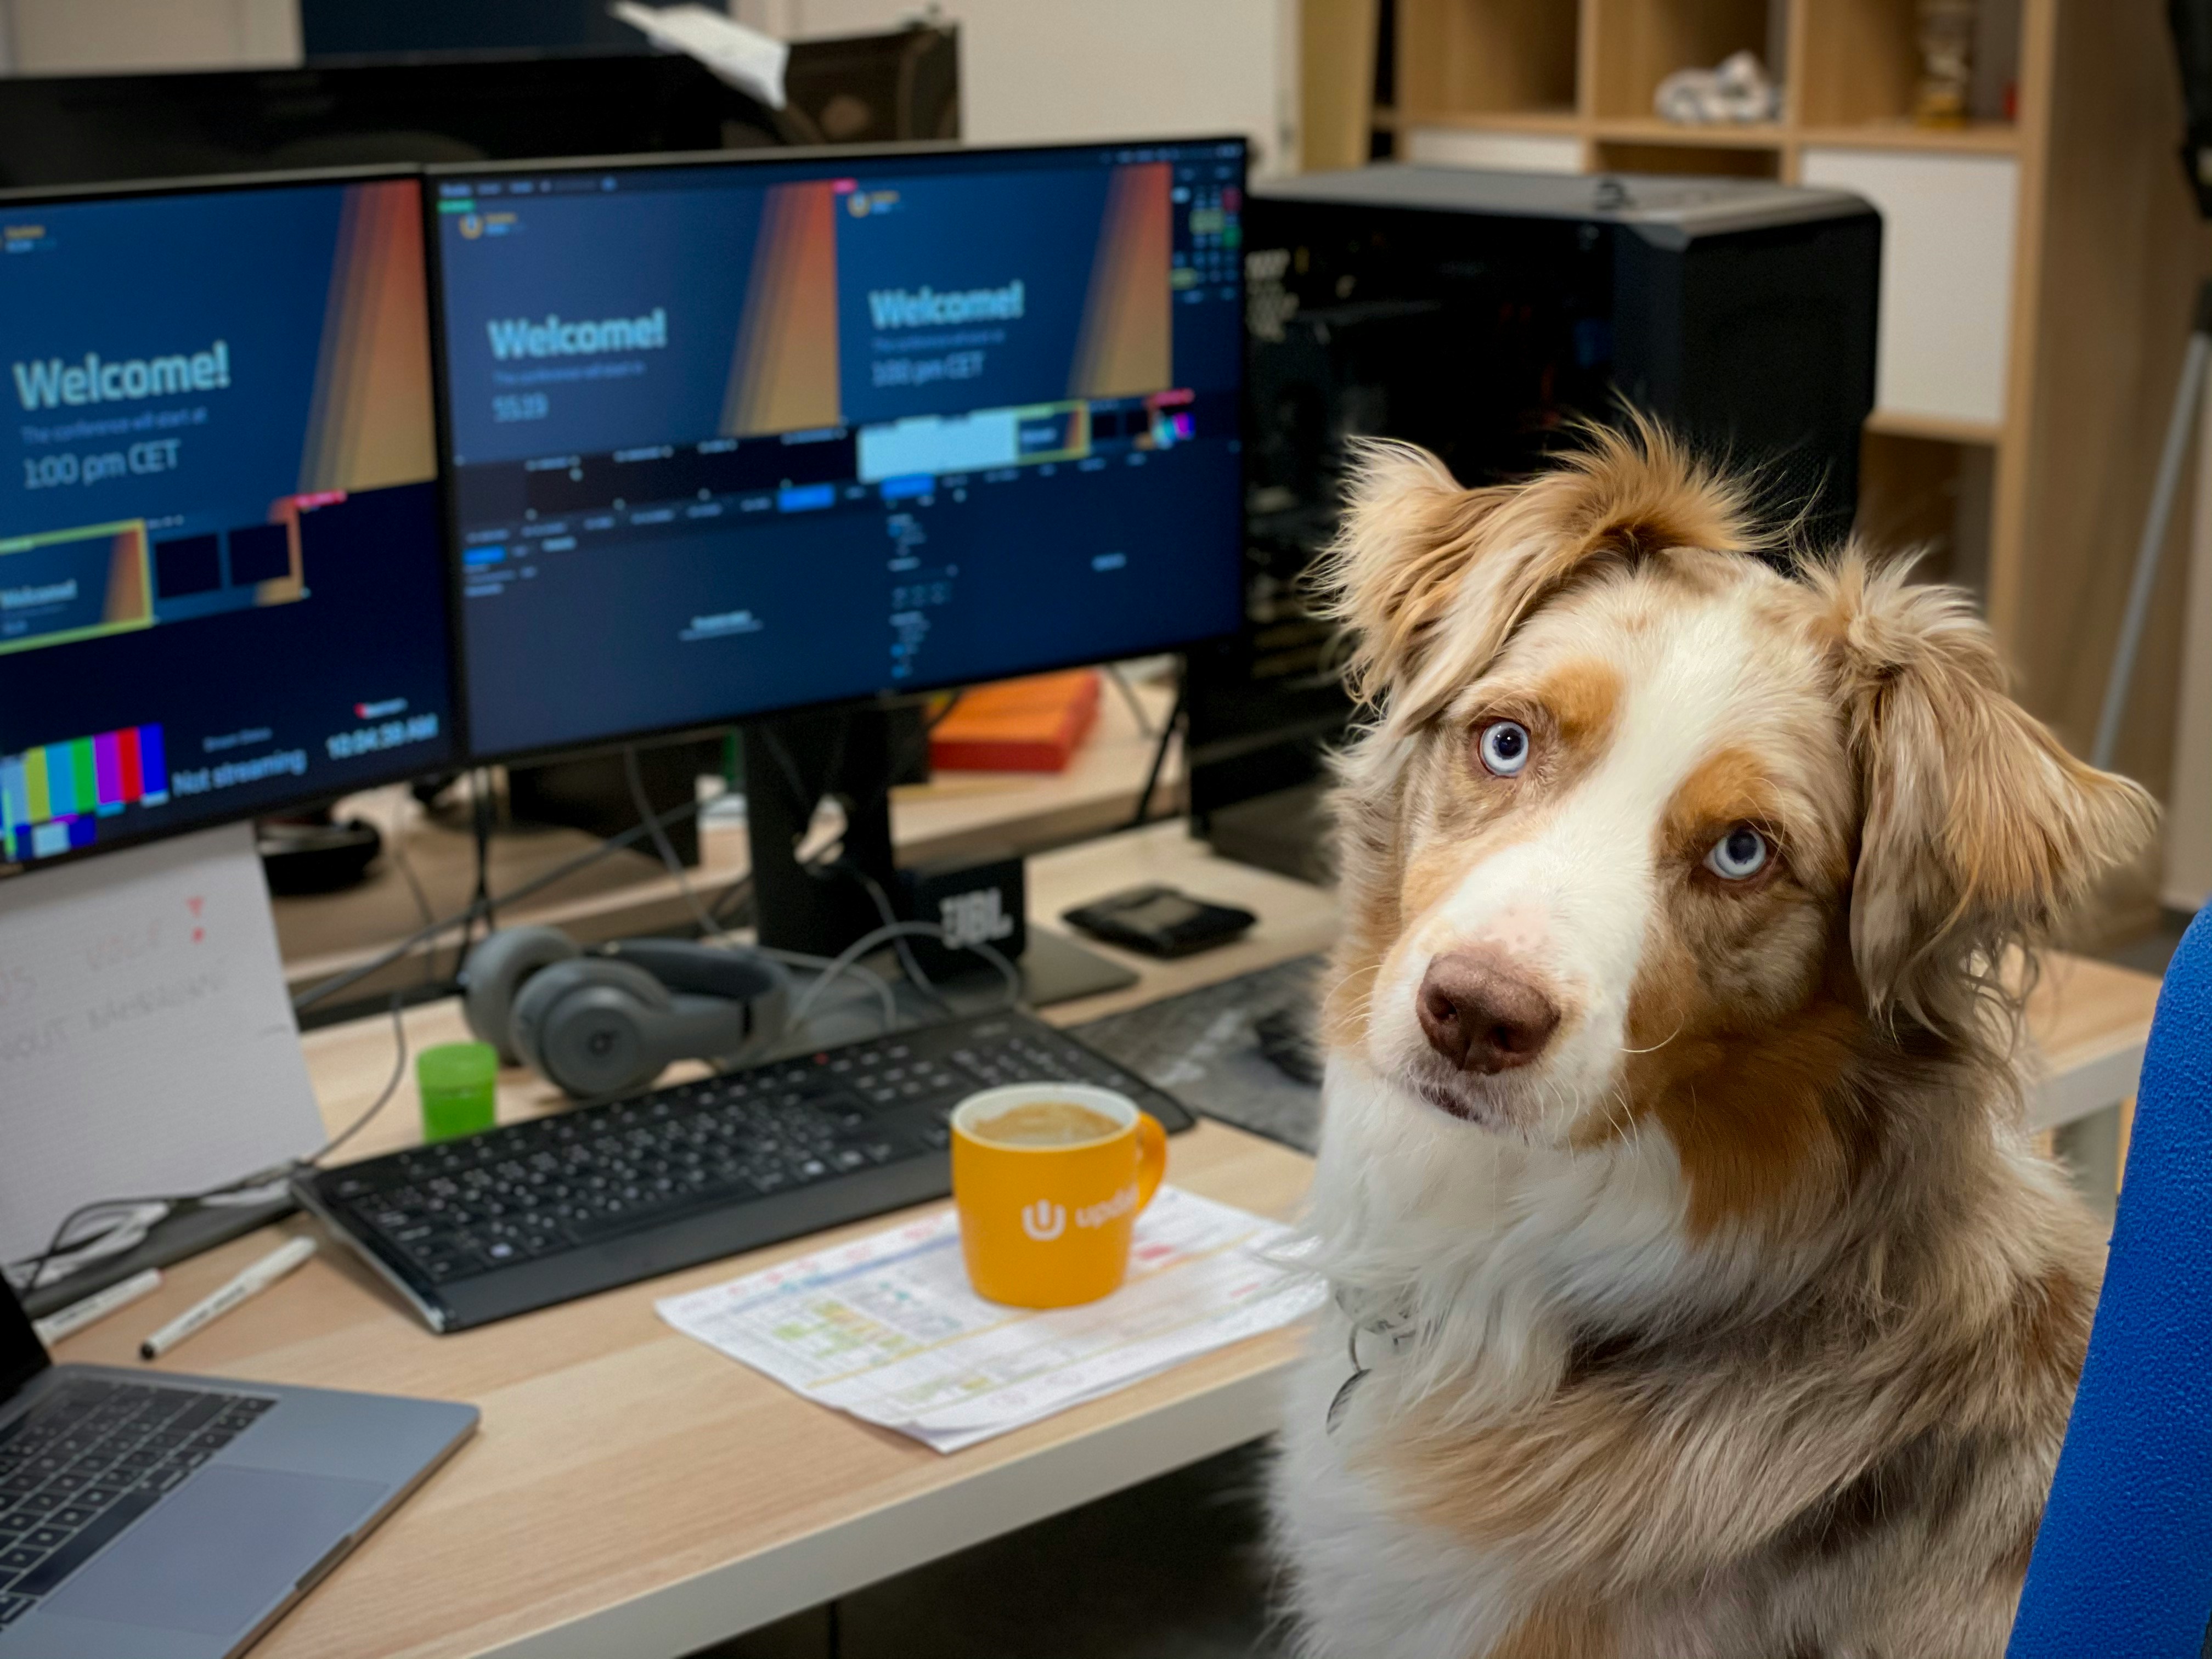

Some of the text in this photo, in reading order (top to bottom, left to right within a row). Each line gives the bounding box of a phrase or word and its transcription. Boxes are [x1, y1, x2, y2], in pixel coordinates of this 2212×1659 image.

[486, 307, 667, 360] Welcome!
[12, 340, 232, 411] Welcome!
[82, 451, 125, 485] pm
[128, 438, 181, 475] CET
[939, 887, 1014, 950] JBL
